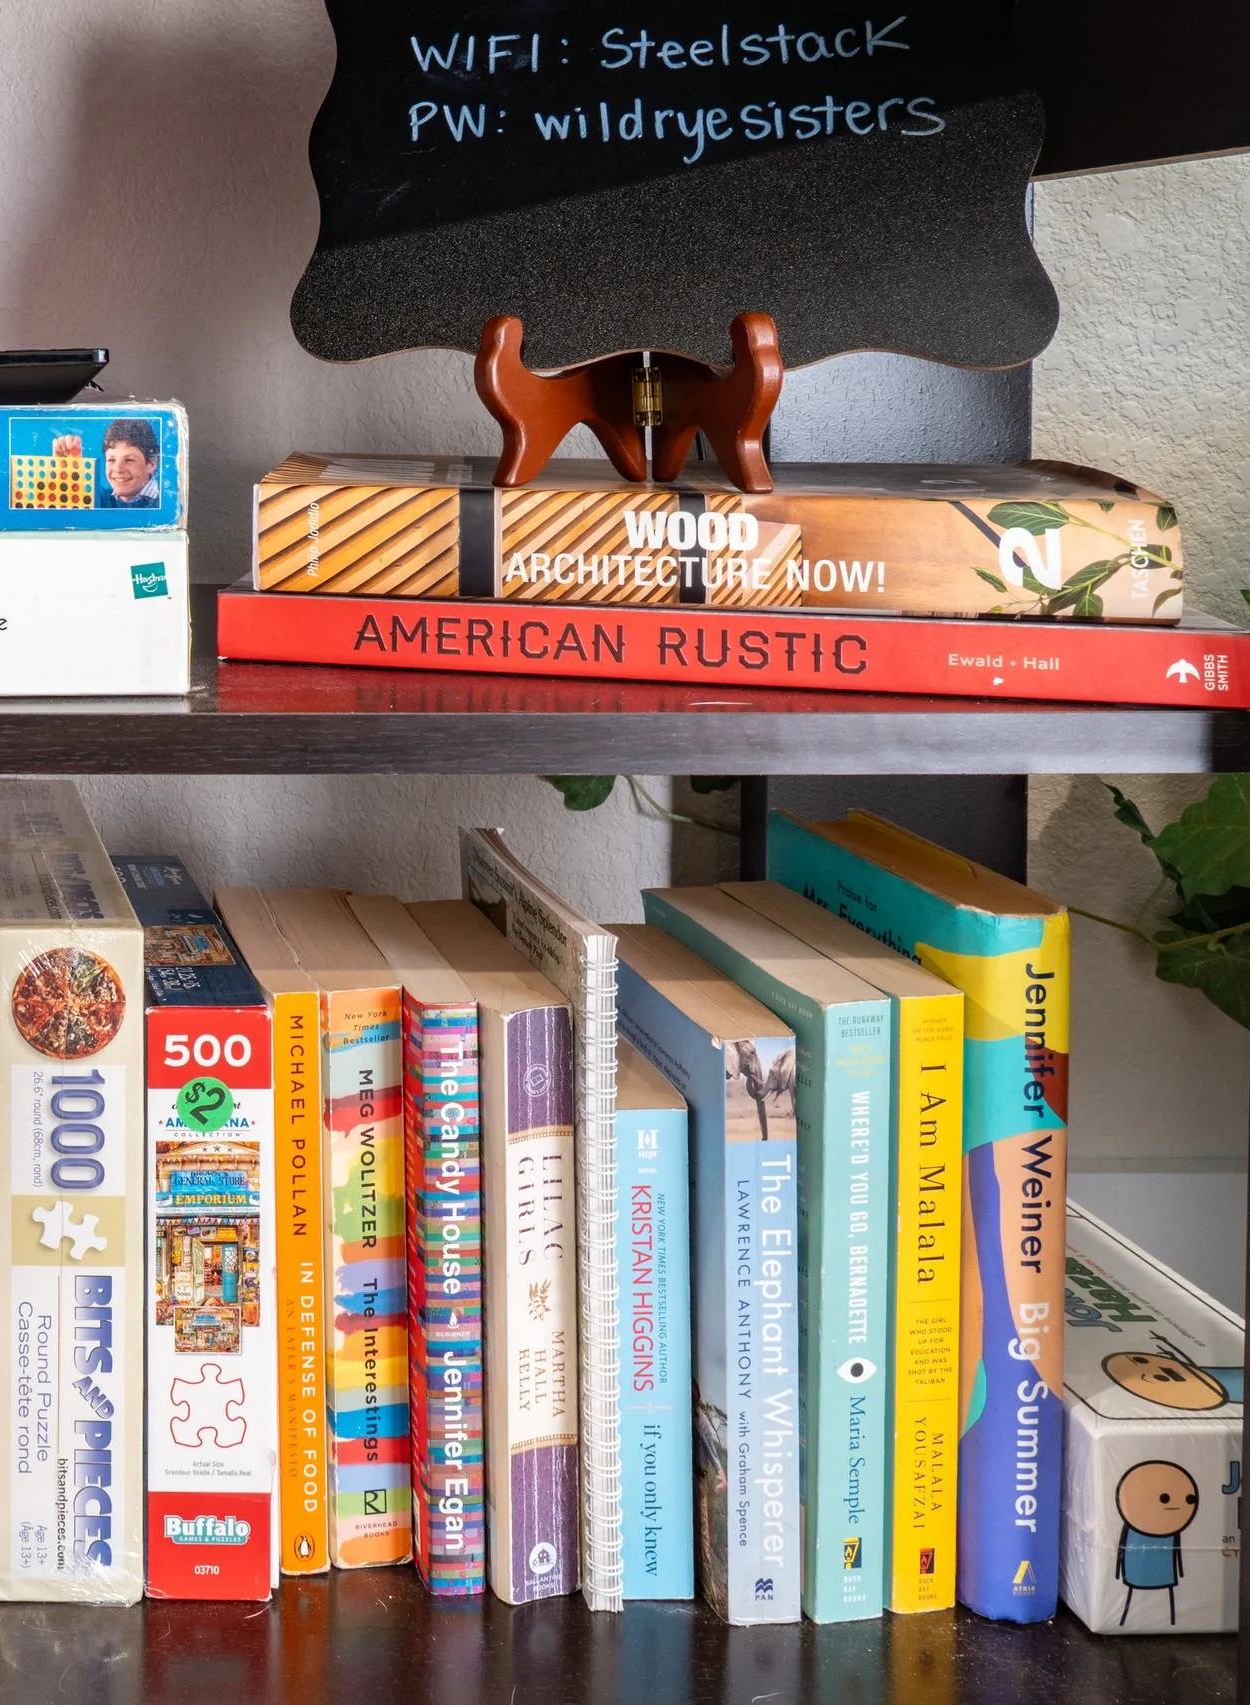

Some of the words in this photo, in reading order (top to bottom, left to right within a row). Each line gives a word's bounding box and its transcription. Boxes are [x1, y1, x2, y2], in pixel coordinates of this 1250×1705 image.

[407, 101, 506, 141] PW:
[534, 95, 946, 163] wildryesisters
[624, 510, 759, 551] WOOD
[1130, 518, 1148, 601] TASCHEN
[504, 552, 772, 590] ARCHITECTURE
[786, 558, 886, 593] NOW!
[353, 614, 627, 663] AMERICAN
[657, 626, 868, 675] RUSTIC
[948, 653, 1004, 668] Ewald
[1023, 656, 1060, 670] Hall
[1204, 654, 1215, 691] GIBBS
[1217, 654, 1228, 692] SMITH
[343, 1033, 390, 1045] Bestseller
[344, 1012, 363, 1021] New
[367, 1010, 388, 1020] York
[353, 1022, 380, 1032] Times
[838, 1017, 850, 1026] THE
[852, 1014, 884, 1024] RUNAWAY
[841, 1029, 881, 1038] BESTSELLER
[1022, 963, 1055, 1119] Jennifer
[163, 1034, 252, 1067] 500
[290, 1015, 306, 1125] MICHAEL
[440, 1035, 464, 1096] The
[920, 1064, 947, 1075] I
[185, 1081, 226, 1126] $2
[359, 1069, 375, 1118] MEG
[920, 1092, 947, 1148] Am
[50, 1069, 106, 1189] 1000
[436, 1102, 465, 1195] Candy
[638, 1150, 657, 1159] HQN
[850, 1090, 870, 1164] WHERE'D
[175, 1193, 248, 1206] EMPORIUM
[291, 1139, 307, 1236] POLLAN
[360, 1127, 378, 1249] WOLITZER
[518, 1156, 535, 1266] GIRLS
[542, 1154, 563, 1260] LILAC
[657, 1193, 666, 1215] NEW
[761, 1154, 791, 1214] The
[849, 1169, 870, 1206] YOU
[1019, 1135, 1053, 1274] Weiner
[441, 1203, 463, 1295] House
[631, 1185, 653, 1284] KRISTAN
[657, 1218, 666, 1244] YORK
[737, 1179, 750, 1288] LAWRENCE
[848, 1211, 869, 1239] GO,
[917, 1163, 946, 1284] Malala
[300, 1262, 314, 1283] IN
[657, 1247, 666, 1273] TIMES
[73, 1275, 113, 1375] BITS
[363, 1278, 378, 1318] The
[657, 1277, 667, 1342] BESTSELLING
[753, 1228, 792, 1377] Elephant
[848, 1245, 869, 1345] BERNADETTE
[17, 1301, 33, 1418] Casse-tête
[36, 1314, 52, 1384] Round
[300, 1296, 316, 1398] DEFENSE
[632, 1292, 654, 1392] HIGGINS
[737, 1300, 751, 1399] ANTHONY
[1007, 1302, 1049, 1362] Big
[363, 1327, 379, 1462] Interestings
[519, 1348, 531, 1412] KELLY
[534, 1348, 548, 1405] HALL
[552, 1330, 565, 1418] MARTHA
[658, 1345, 667, 1384] AUTHOR
[36, 1393, 51, 1462] Puzzle
[71, 1375, 115, 1420] AND
[302, 1409, 317, 1438] OF
[443, 1351, 468, 1474] Jennifer
[738, 1411, 747, 1438] with
[850, 1395, 866, 1452] Maria
[17, 1425, 32, 1474] rond
[640, 1445, 658, 1478] you
[644, 1424, 661, 1439] if
[1014, 1380, 1048, 1533] Summer
[72, 1420, 113, 1571] PIECES
[303, 1449, 318, 1512] FOOD
[738, 1443, 750, 1496] Graham
[754, 1387, 793, 1567] Whisperer
[843, 1456, 865, 1525] Semple
[914, 1417, 926, 1529] YOUSAFZAI
[932, 1433, 943, 1511] MALALA
[165, 1516, 249, 1537] Buffalo
[355, 1521, 398, 1530] RIVERHEAD
[438, 1478, 468, 1550] Egan
[640, 1480, 662, 1526] only
[736, 1501, 750, 1547] Spence
[364, 1530, 390, 1539] BOOKS
[644, 1528, 662, 1577] knew
[194, 1565, 220, 1575] 03710
